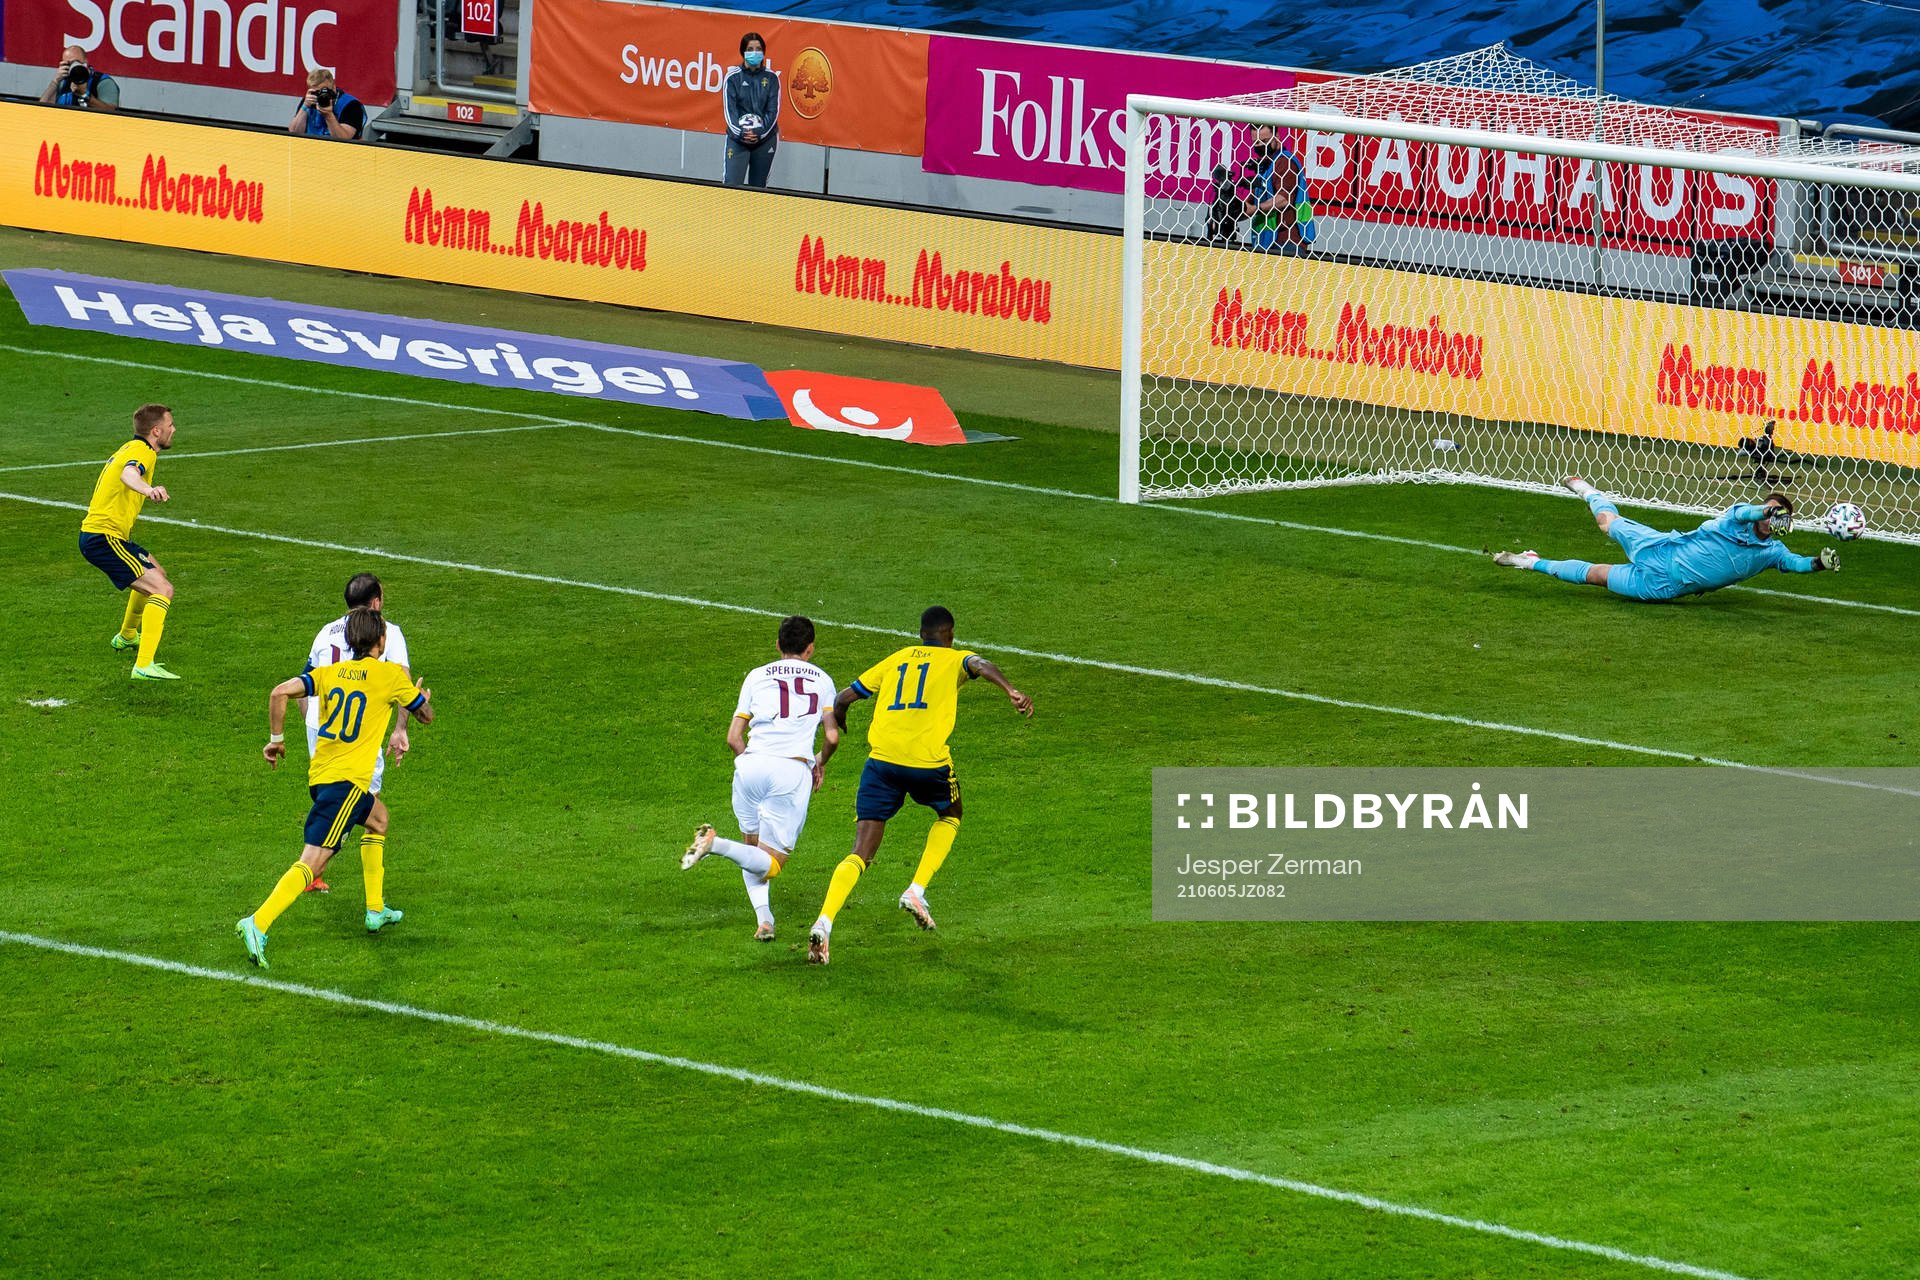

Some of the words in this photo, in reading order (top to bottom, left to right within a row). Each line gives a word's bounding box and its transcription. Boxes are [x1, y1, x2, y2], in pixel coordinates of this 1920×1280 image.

[63, 0, 338, 79] Scandic
[467, 2, 492, 22] 102
[620, 44, 782, 93] Swedb
[455, 105, 475, 120] 102
[973, 68, 1234, 180] Folksam
[35, 141, 264, 223] Mmm...Marabou
[1304, 103, 1757, 227] BAUHAUS
[405, 187, 647, 271] Mmm...Marabou
[795, 234, 1051, 324] Mmm...Marabou
[1851, 265, 1872, 281] 101
[54, 285, 277, 346] Heja
[288, 318, 700, 400] Sverige!
[1657, 342, 1920, 436] Mmm...Marab
[337, 668, 368, 681] OLSSON
[773, 677, 819, 719] 15
[887, 662, 930, 711] 11
[317, 687, 368, 743] 20
